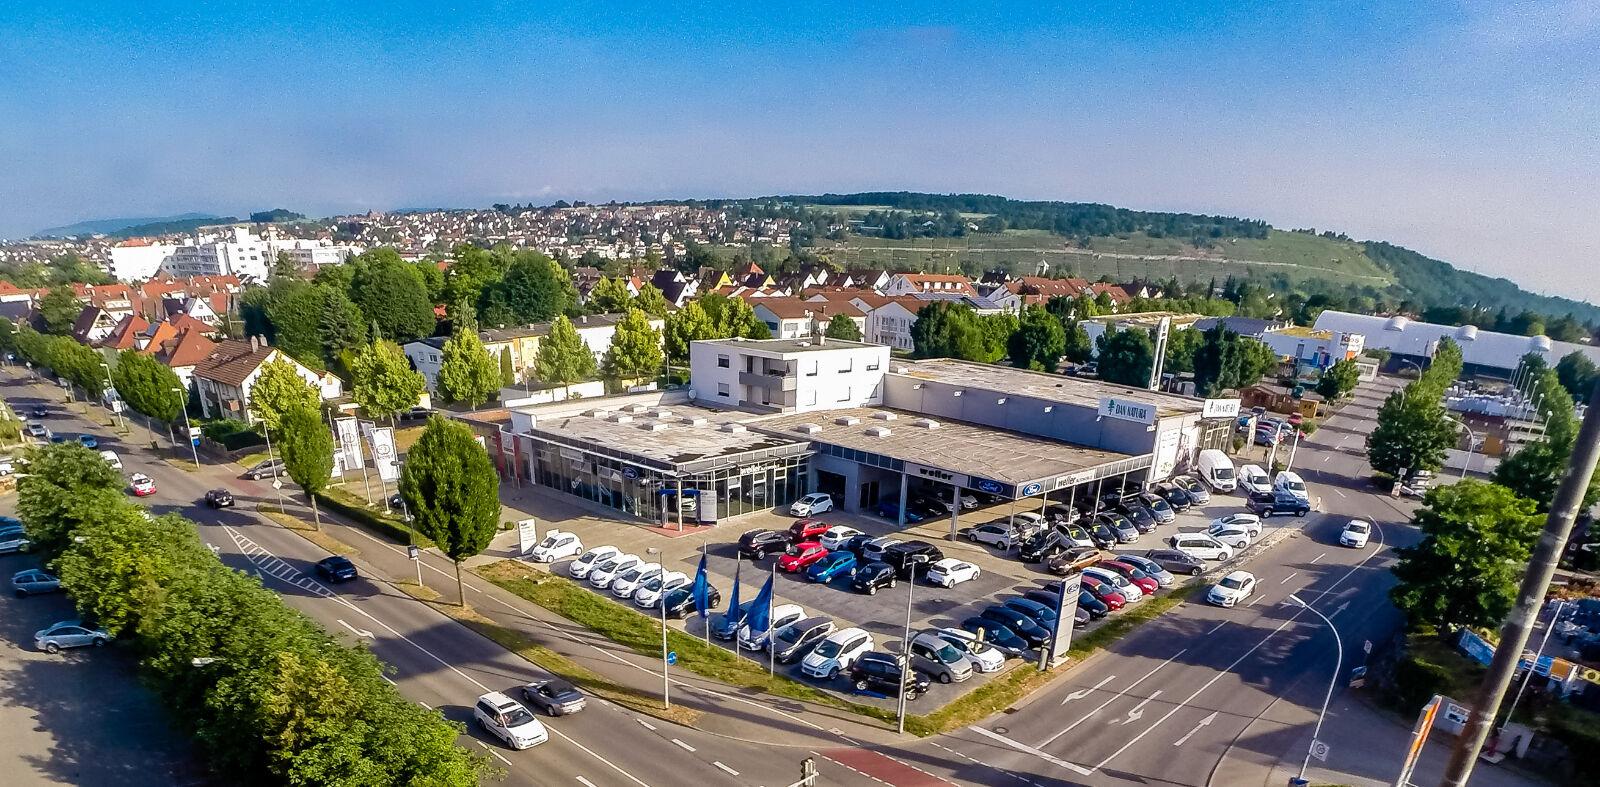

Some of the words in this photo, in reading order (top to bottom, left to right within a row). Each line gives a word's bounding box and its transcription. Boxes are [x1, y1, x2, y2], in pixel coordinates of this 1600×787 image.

[1115, 404, 1128, 416] DAN
[1127, 405, 1147, 419] NATURA
[919, 467, 953, 480] weller
[1058, 475, 1076, 487] weller
